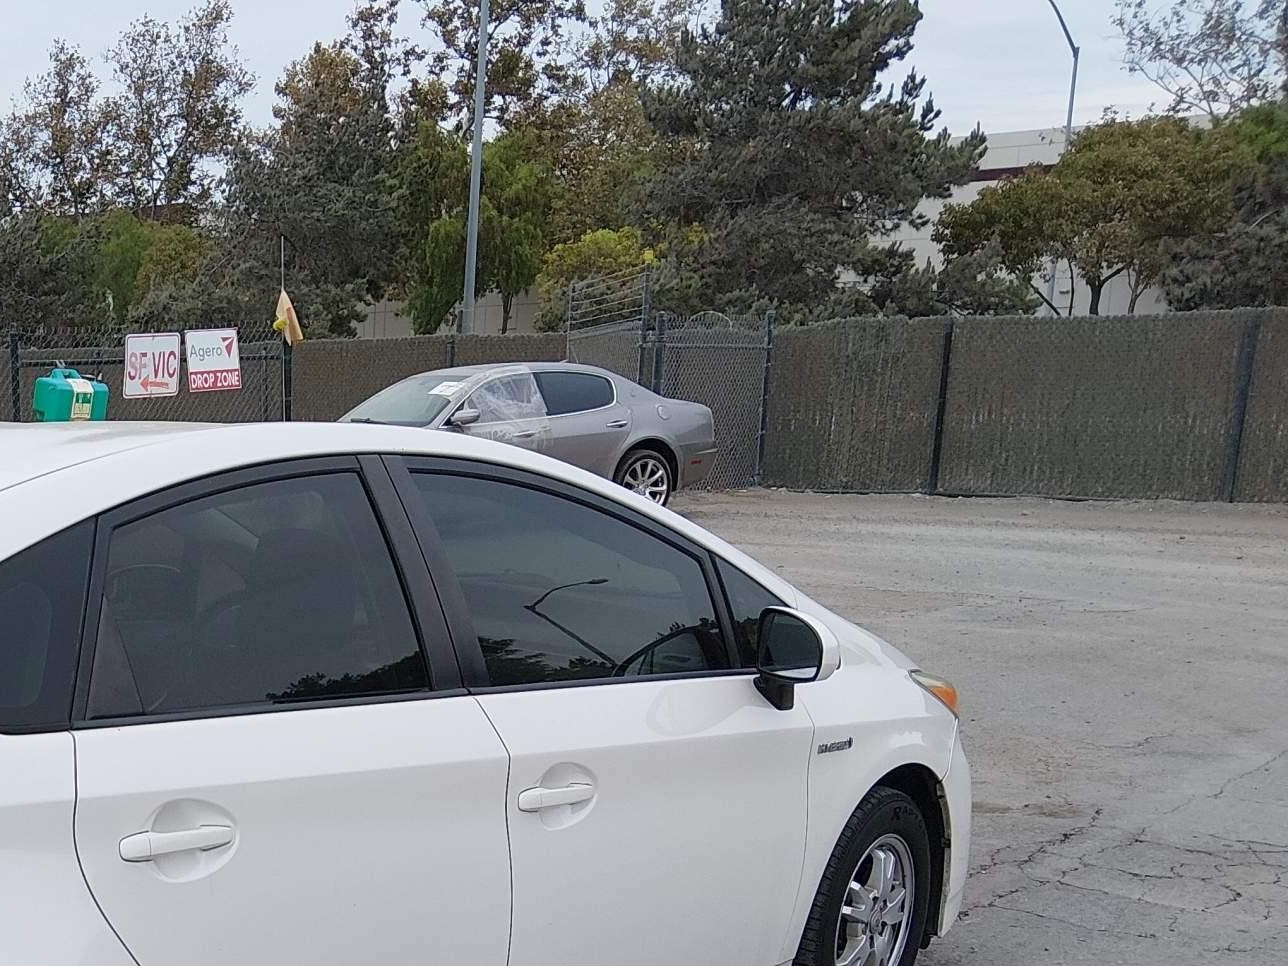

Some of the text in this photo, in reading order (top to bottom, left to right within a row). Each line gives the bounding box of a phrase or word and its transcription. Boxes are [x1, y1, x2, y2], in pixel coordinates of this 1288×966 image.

[190, 344, 223, 361] Agero
[152, 350, 176, 378] VIC
[190, 371, 240, 388] DROP ZONE
